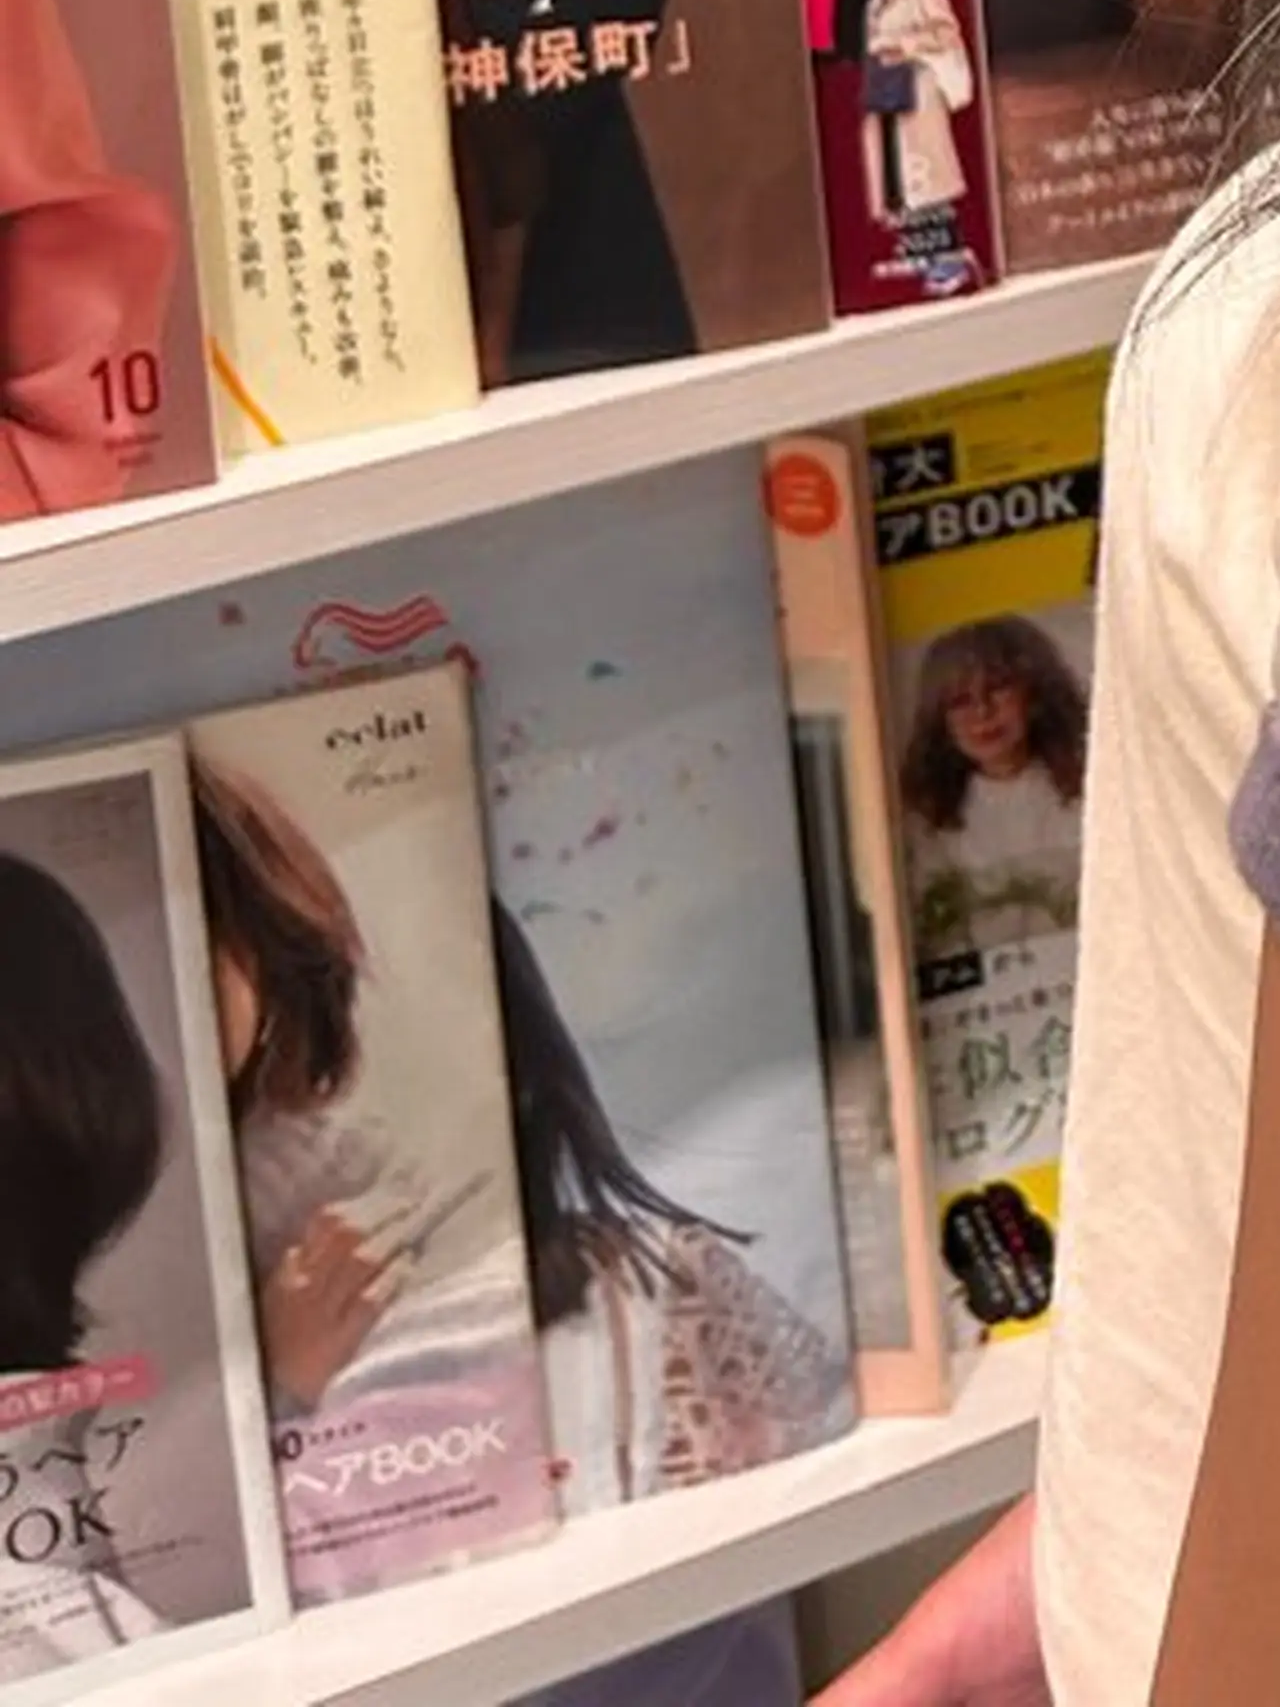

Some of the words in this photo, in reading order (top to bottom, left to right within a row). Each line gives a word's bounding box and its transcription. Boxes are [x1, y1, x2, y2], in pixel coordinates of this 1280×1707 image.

[443, 19, 691, 105] 神保町」
[89, 350, 160, 423] 10
[283, 1417, 506, 1498] ヘアBOOK
[5, 1486, 113, 1564] OK
